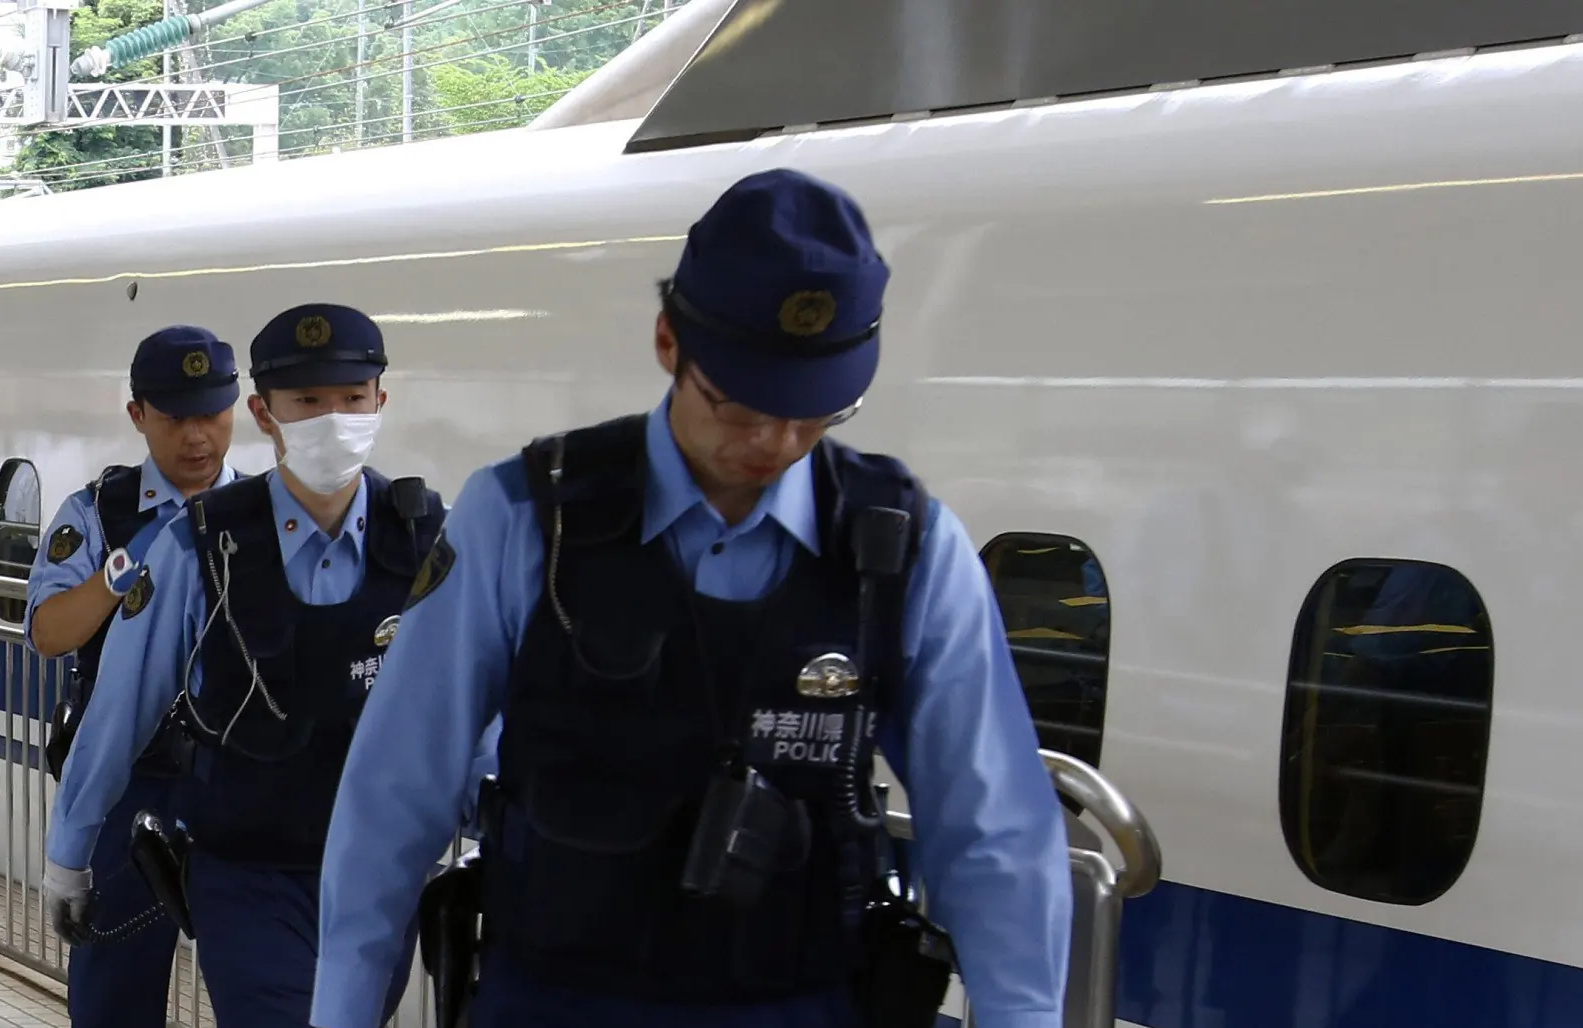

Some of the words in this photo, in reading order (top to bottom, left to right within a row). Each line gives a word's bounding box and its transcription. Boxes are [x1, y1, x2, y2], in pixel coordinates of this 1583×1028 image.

[750, 708, 877, 742] 神奈川県
[773, 741, 842, 763] POLIC
